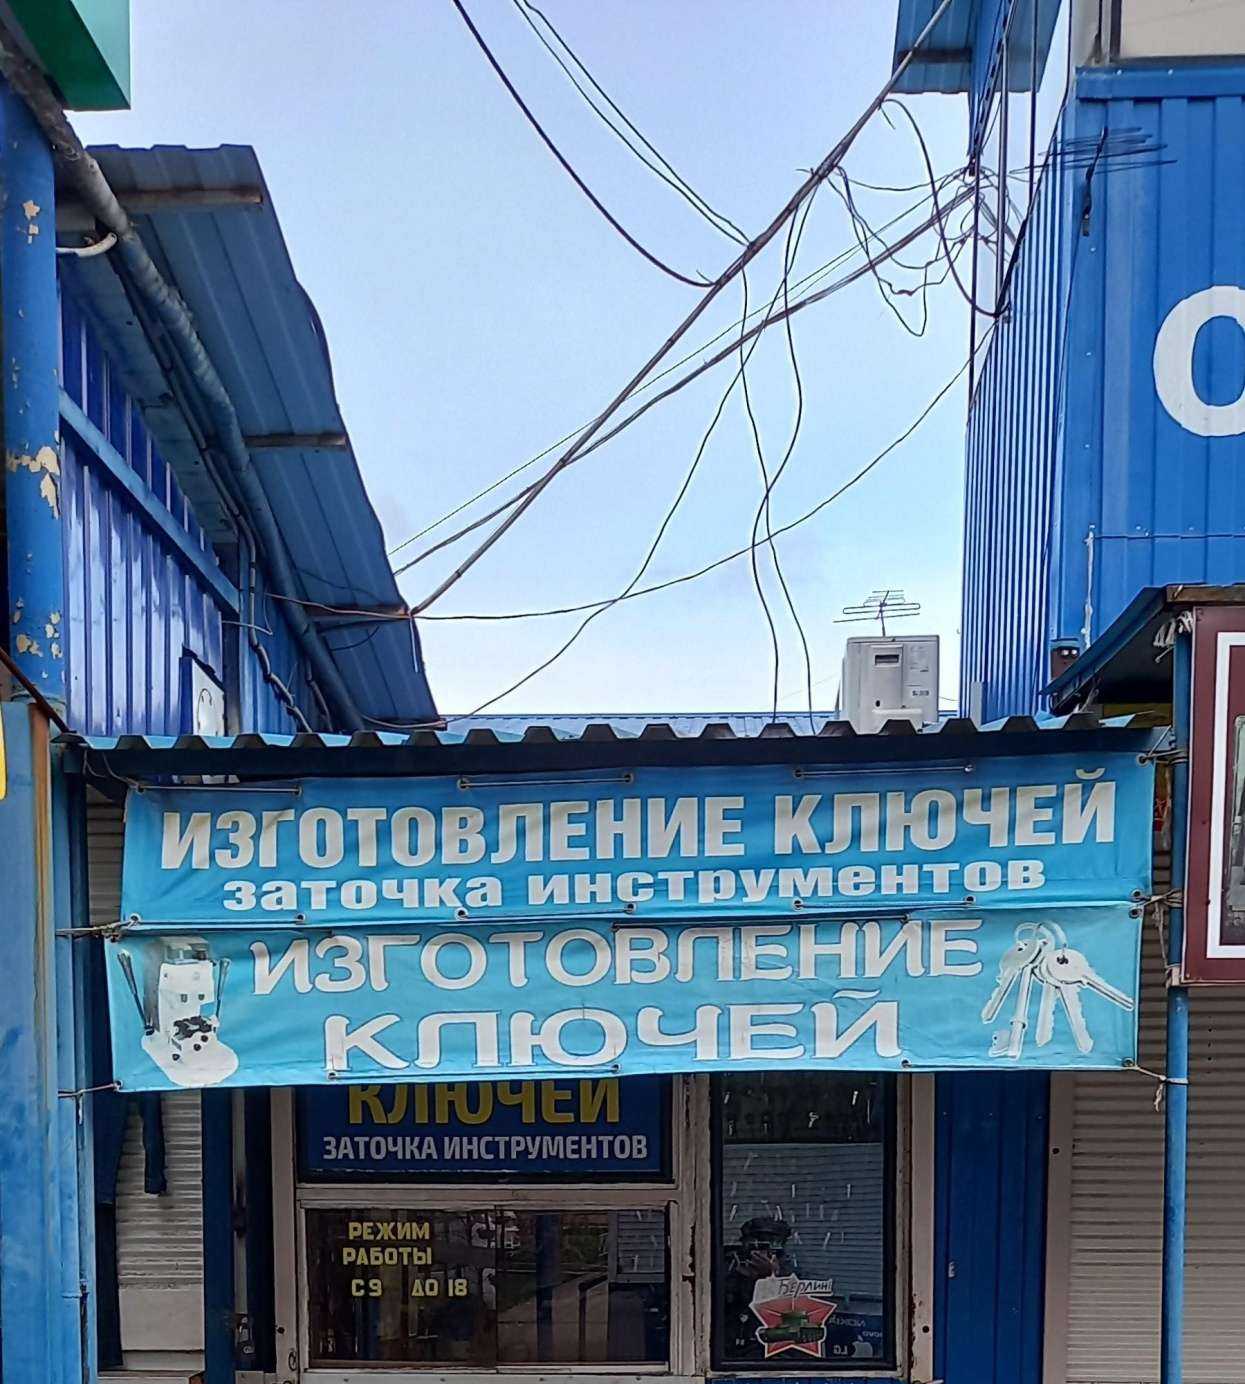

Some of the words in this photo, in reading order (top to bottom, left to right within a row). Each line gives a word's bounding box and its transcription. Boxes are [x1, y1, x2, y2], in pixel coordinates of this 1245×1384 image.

[160, 796, 745, 870] ИЗГОТОВЛЕНИЕ
[774, 767, 1116, 856] КЛЮЧЕЙ
[223, 875, 503, 911] заточка
[528, 859, 1046, 905] инструментов
[249, 919, 985, 996] ИЗГОТОВЛЕНИЕ
[323, 989, 902, 1073] КЛЮЧЕЙ
[322, 1135, 438, 1160] ЗАТОЧКА
[443, 1134, 648, 1160] ИНСТРУМЕНТОВ
[348, 1221, 430, 1241] РЕЖИМ
[342, 1247, 432, 1266] РАБОТЫ
[411, 1278, 439, 1297] ДО
[448, 1278, 468, 1297] 18
